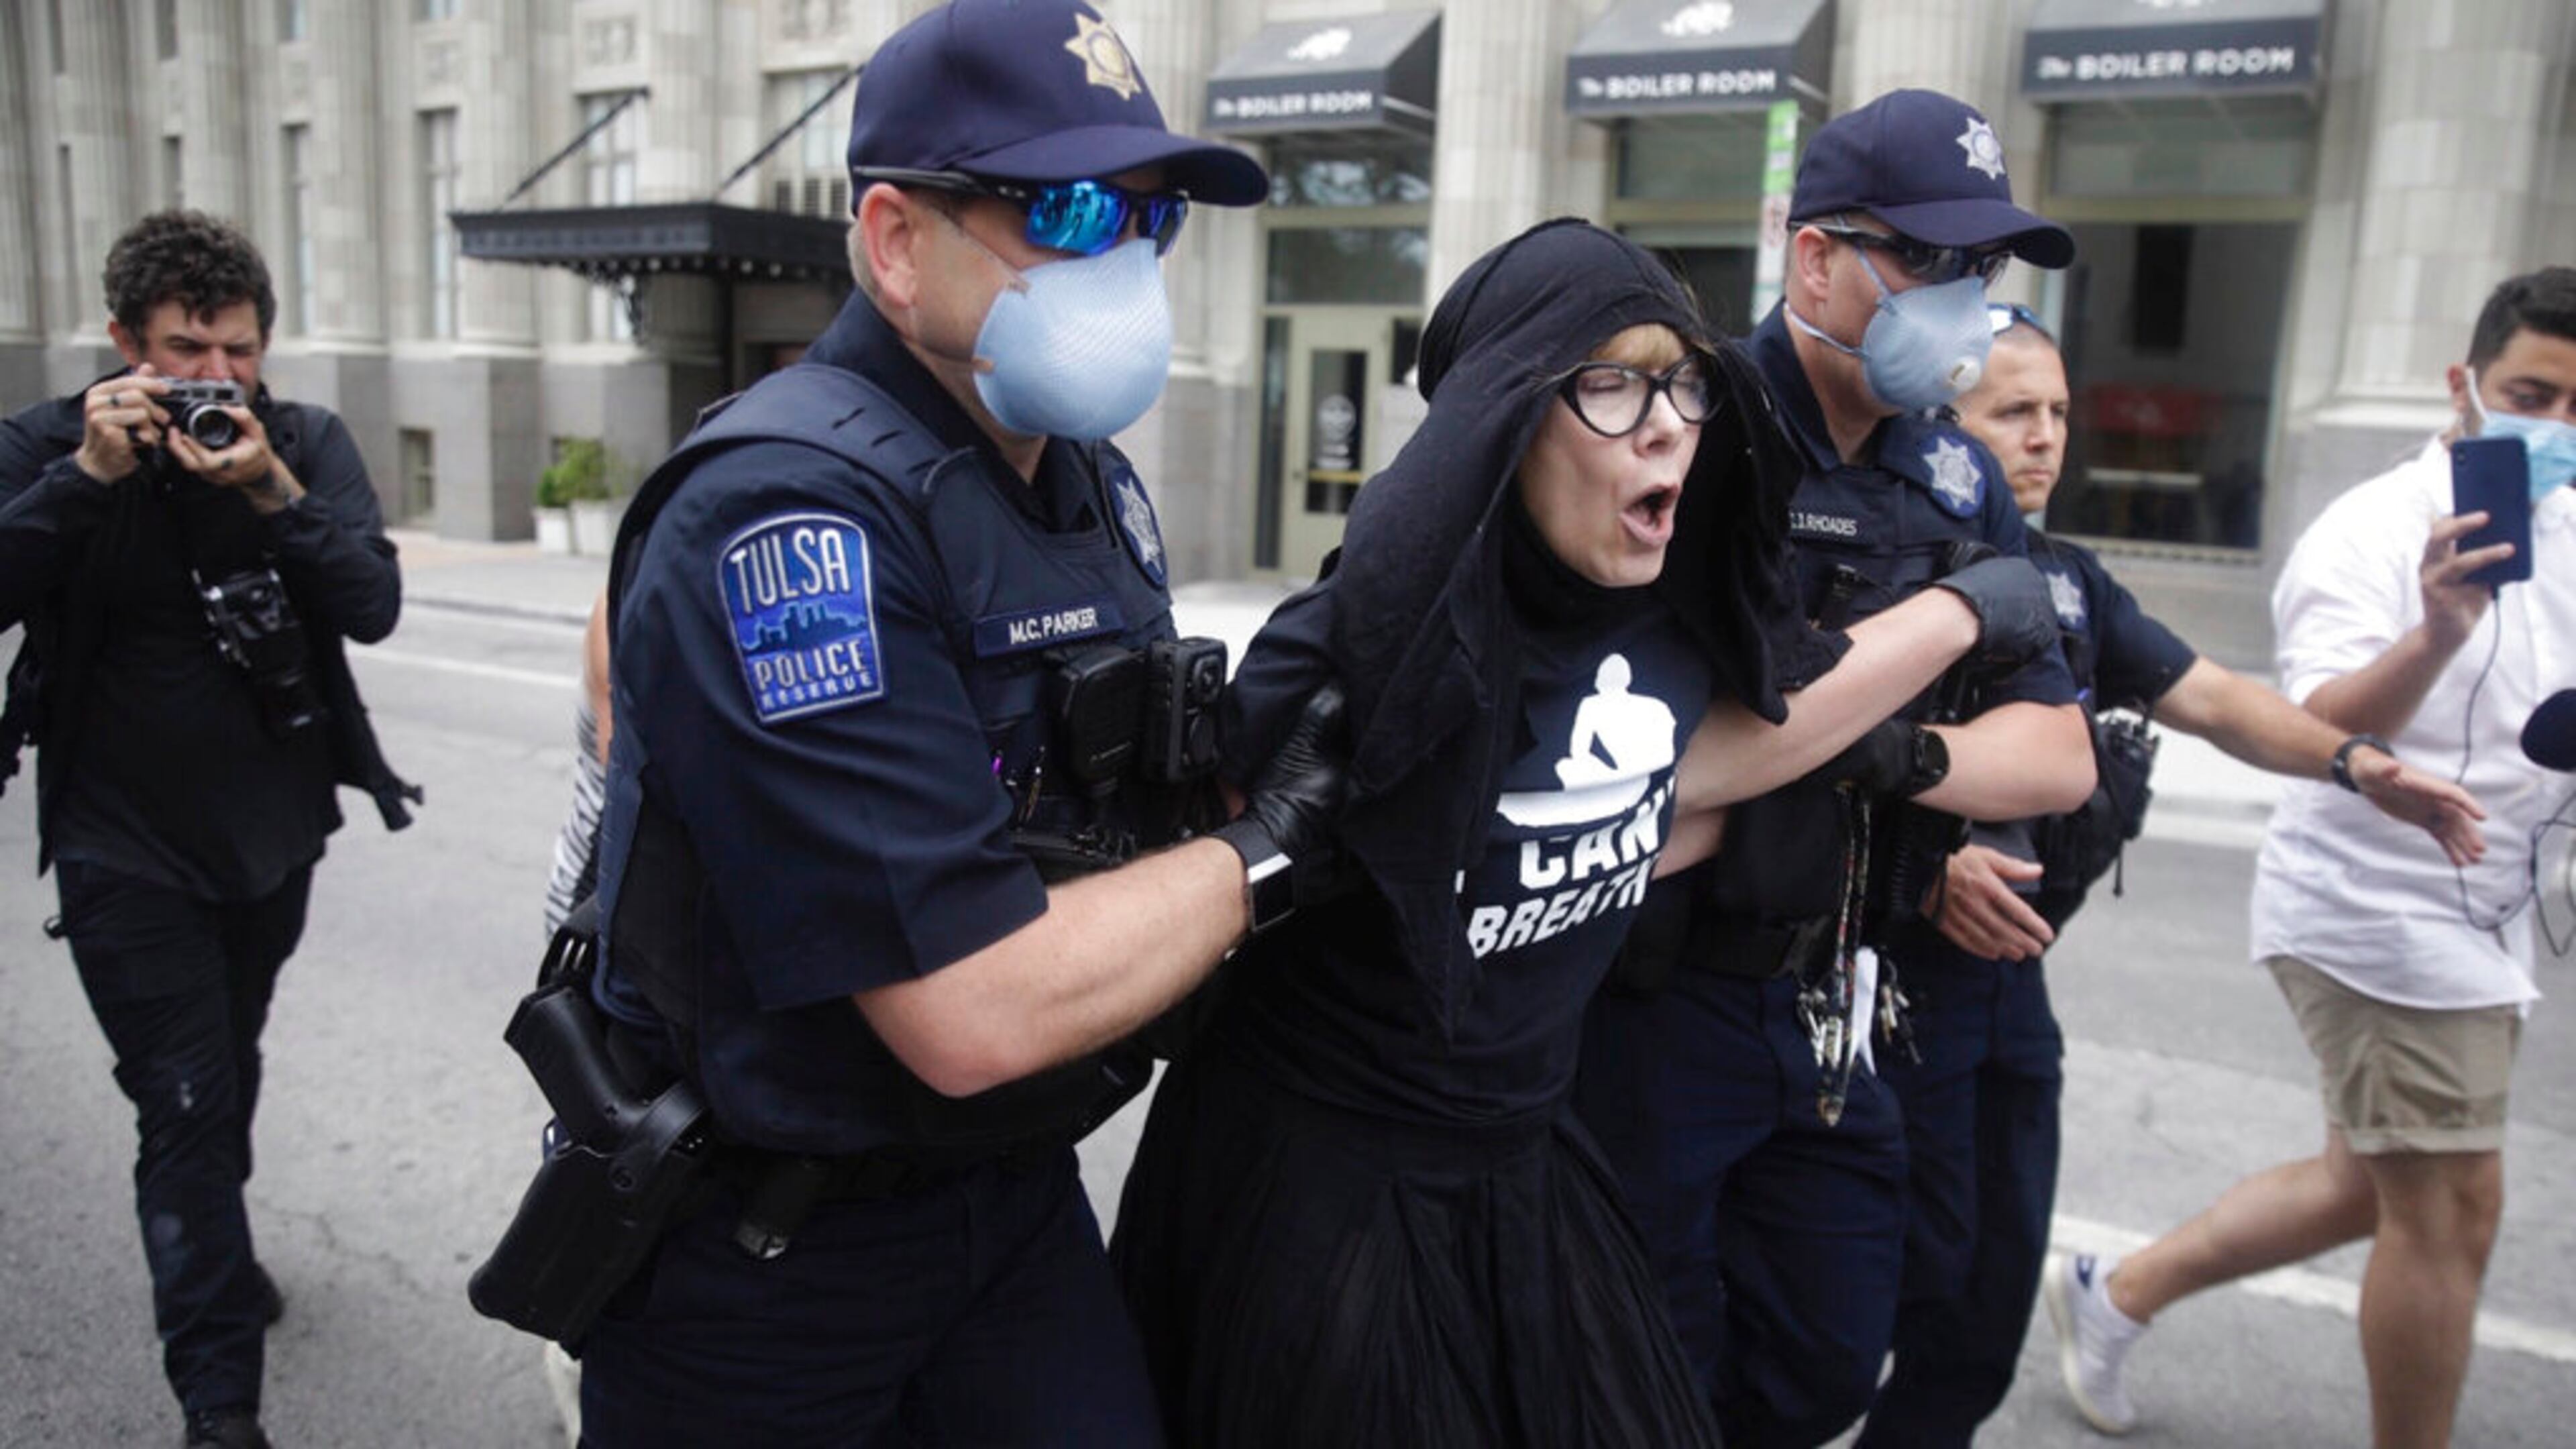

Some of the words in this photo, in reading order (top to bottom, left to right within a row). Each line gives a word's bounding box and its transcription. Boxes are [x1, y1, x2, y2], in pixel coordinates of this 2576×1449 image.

[2076, 50, 2188, 80] BOILER
[2194, 46, 2295, 74] ROOM
[1607, 72, 1693, 98] BOILER
[1698, 69, 1776, 94] ROOM
[1238, 94, 1305, 117] BOILER
[1310, 90, 1373, 113] ROOM
[729, 527, 851, 614] TULSA
[753, 639, 867, 692] POLICE
[760, 670, 873, 710] RESERVE
